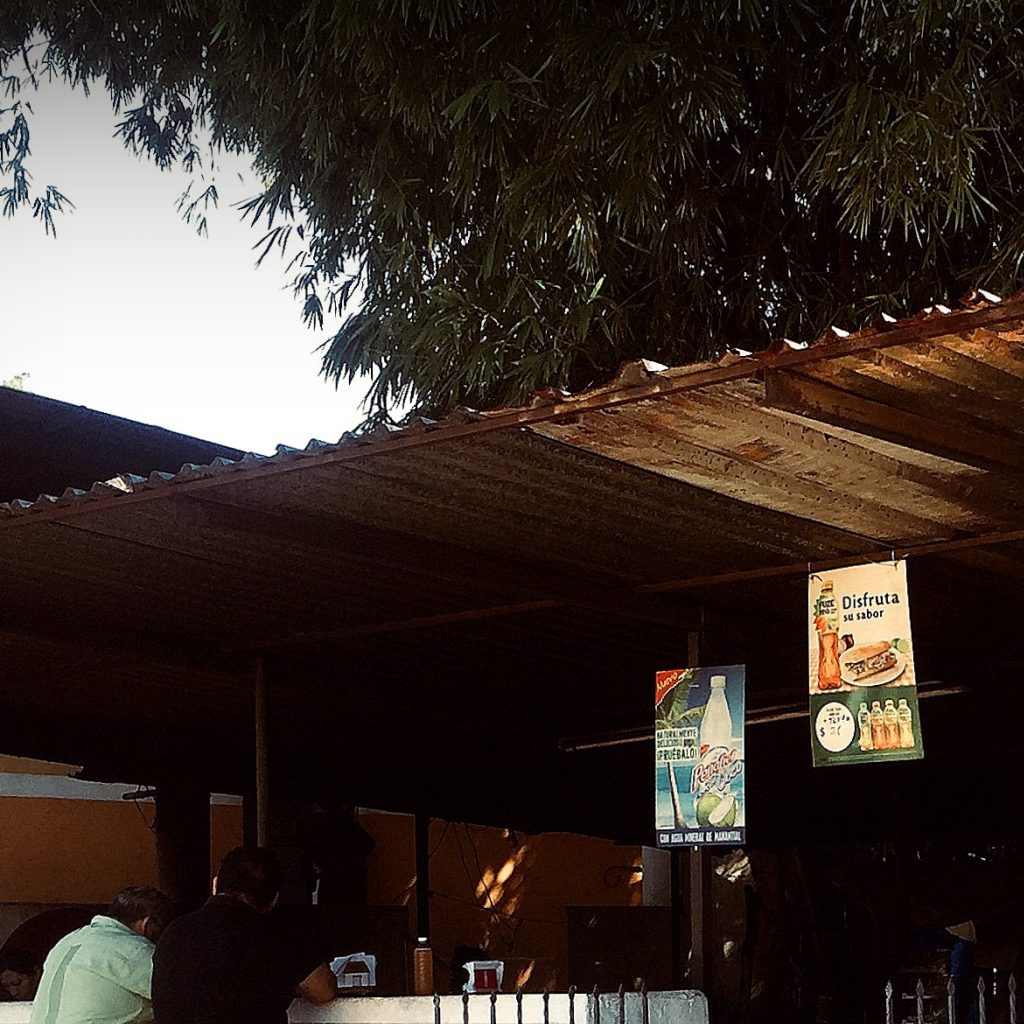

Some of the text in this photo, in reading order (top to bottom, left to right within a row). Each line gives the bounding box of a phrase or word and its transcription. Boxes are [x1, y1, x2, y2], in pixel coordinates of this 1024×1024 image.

[842, 592, 900, 610] Disfruta
[843, 609, 884, 622] su sabor
